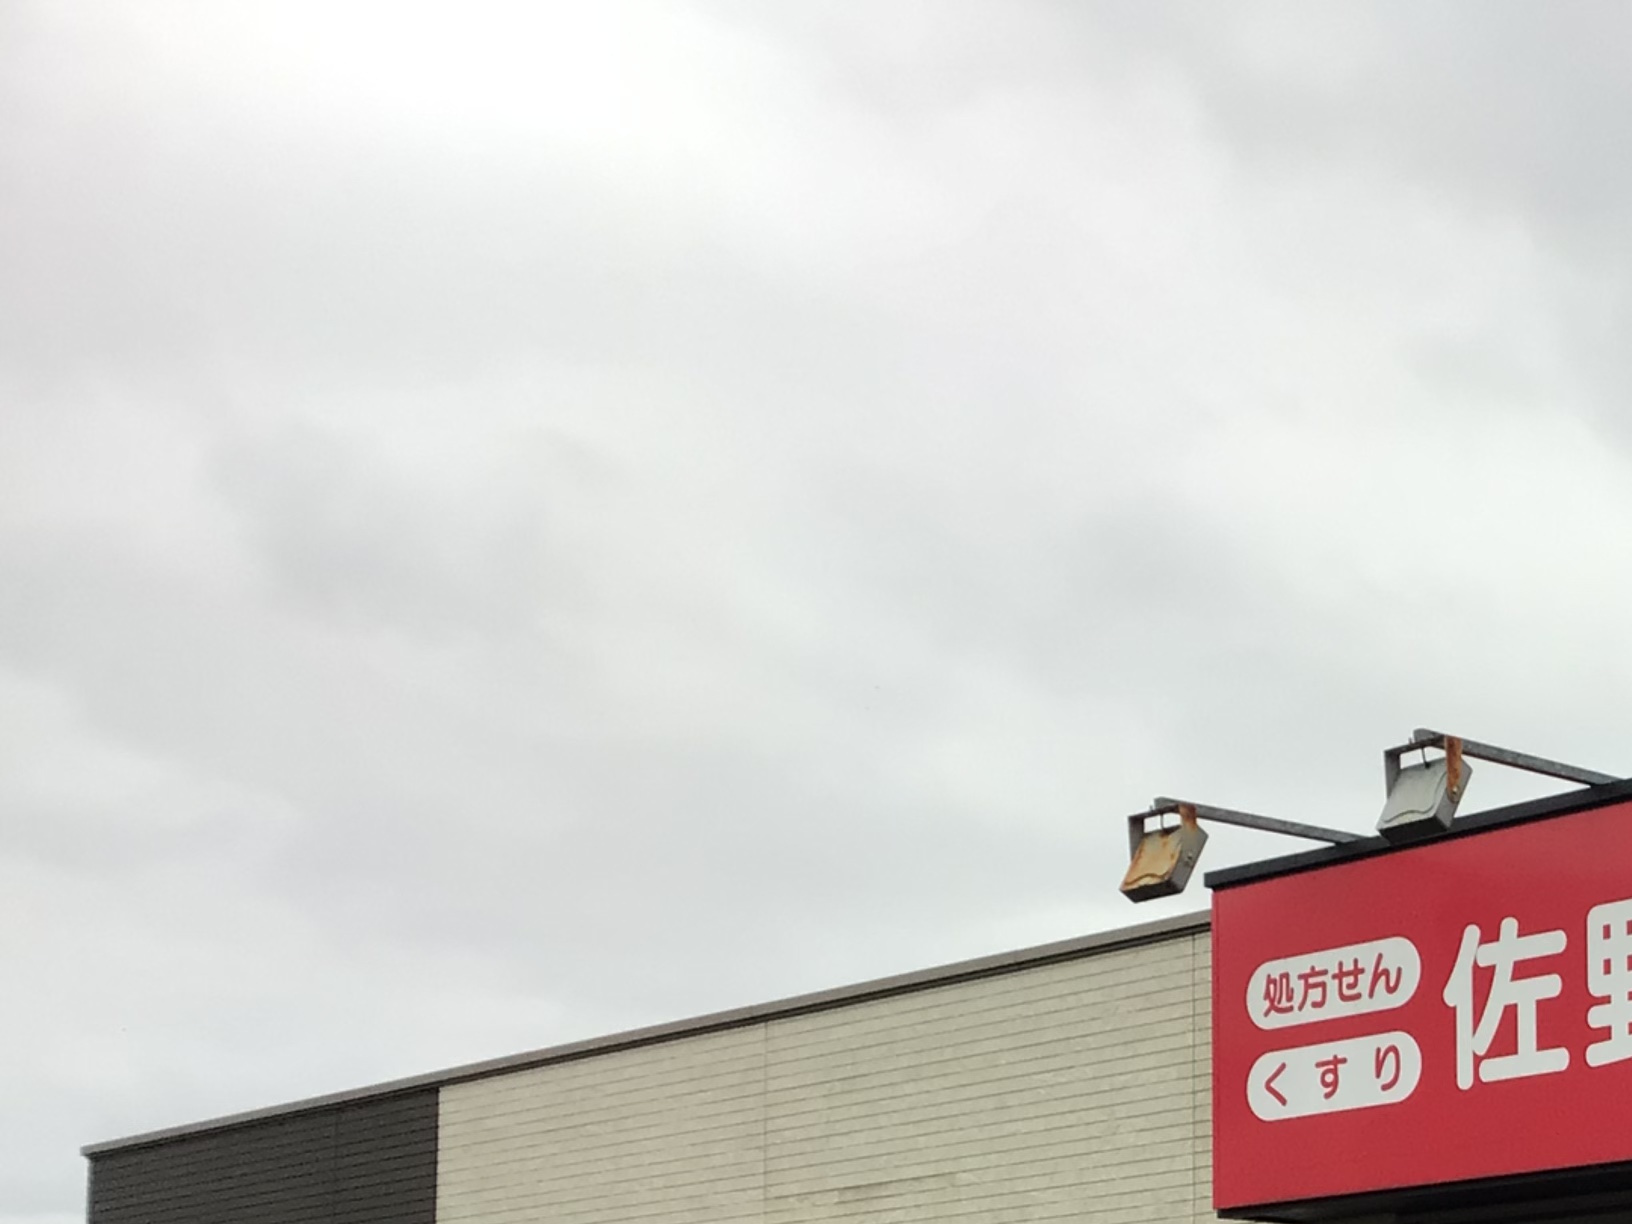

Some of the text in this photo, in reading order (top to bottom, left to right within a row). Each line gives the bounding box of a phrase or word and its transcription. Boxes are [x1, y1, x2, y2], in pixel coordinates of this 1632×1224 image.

[1262, 951, 1404, 1017] 処方せん
[1263, 1043, 1403, 1106] くすり
